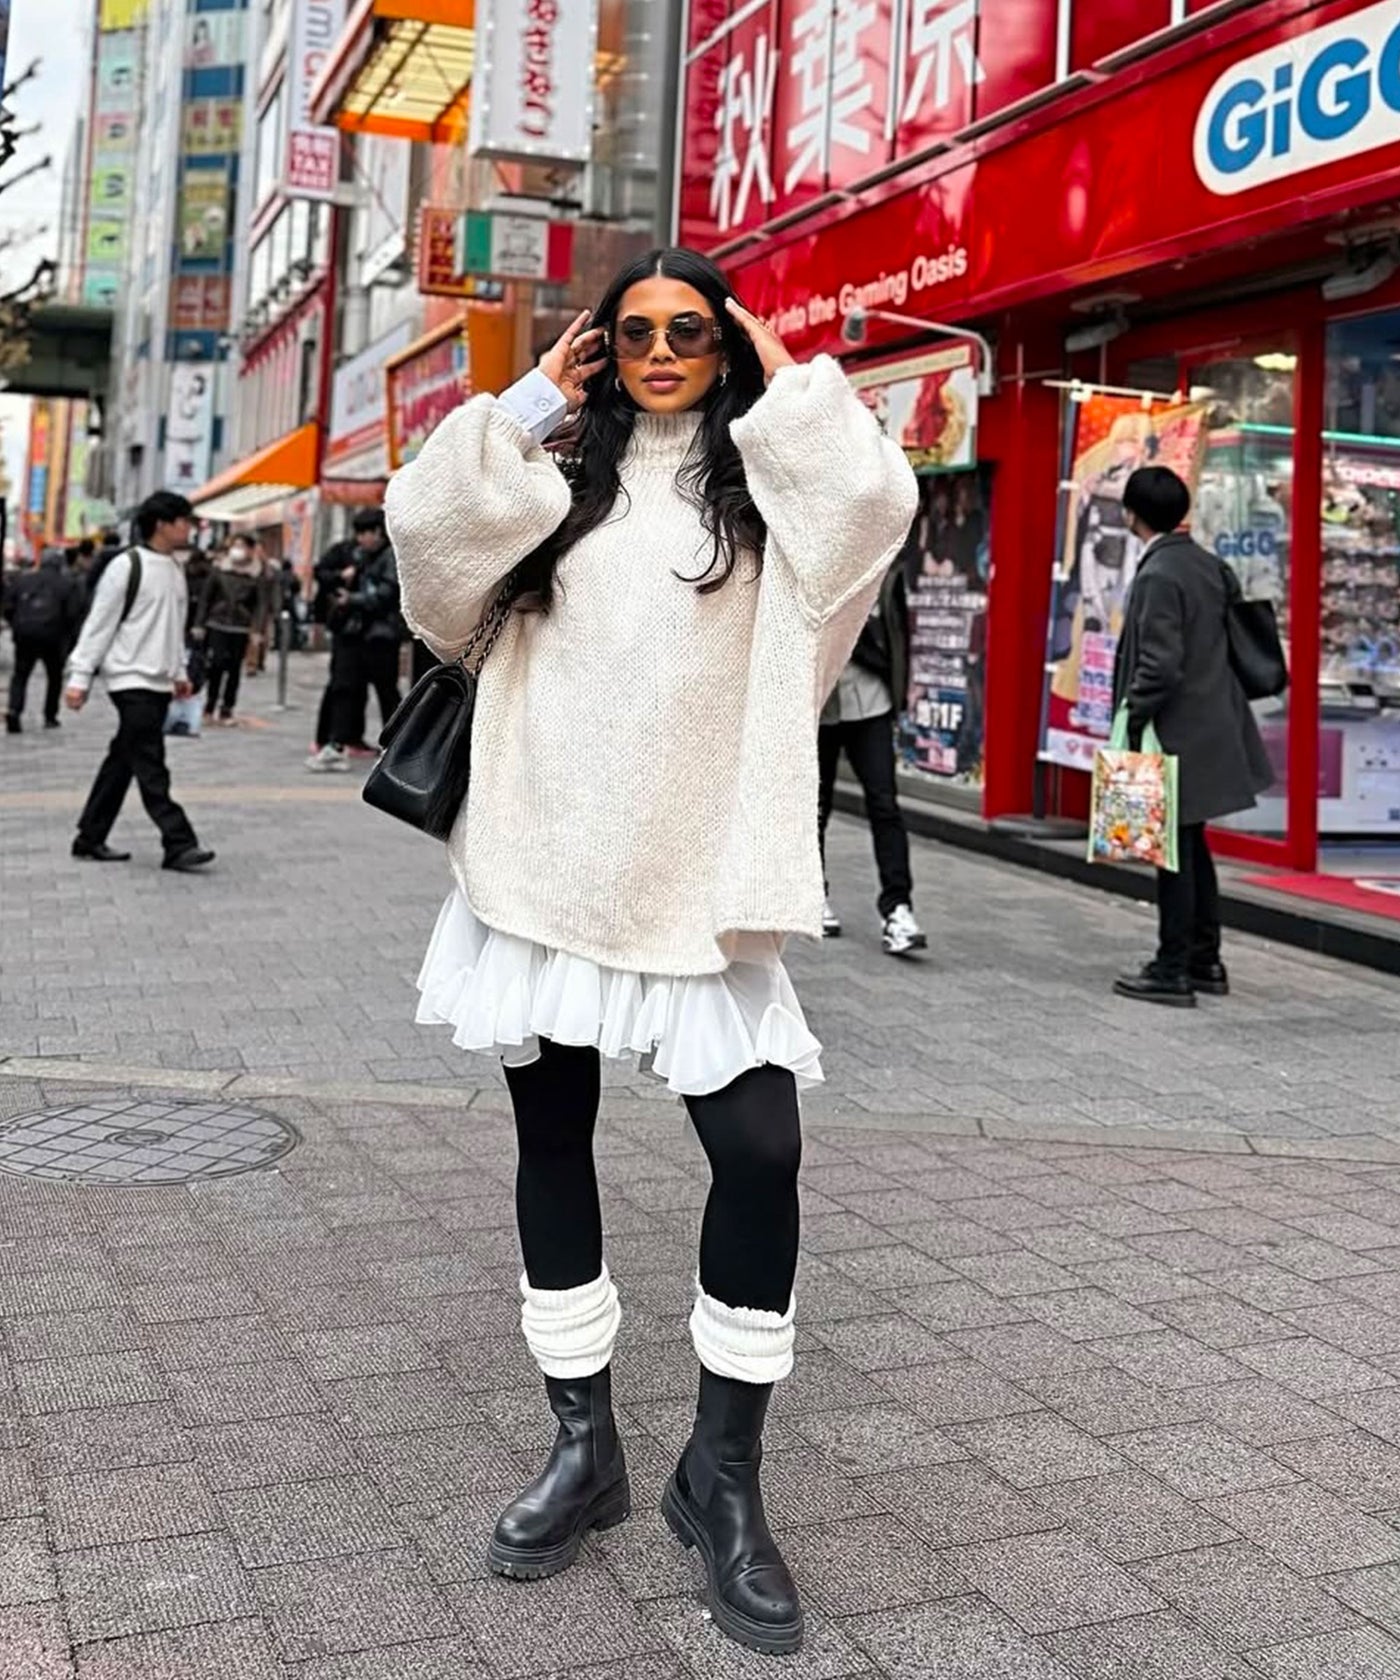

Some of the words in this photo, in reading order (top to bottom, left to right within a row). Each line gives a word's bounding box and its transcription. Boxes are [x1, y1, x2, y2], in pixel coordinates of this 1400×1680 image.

[292, 153, 330, 173] TAX
[778, 304, 806, 336] into
[808, 294, 837, 326] the
[838, 271, 909, 317] Gaming
[910, 244, 968, 291] Oasis
